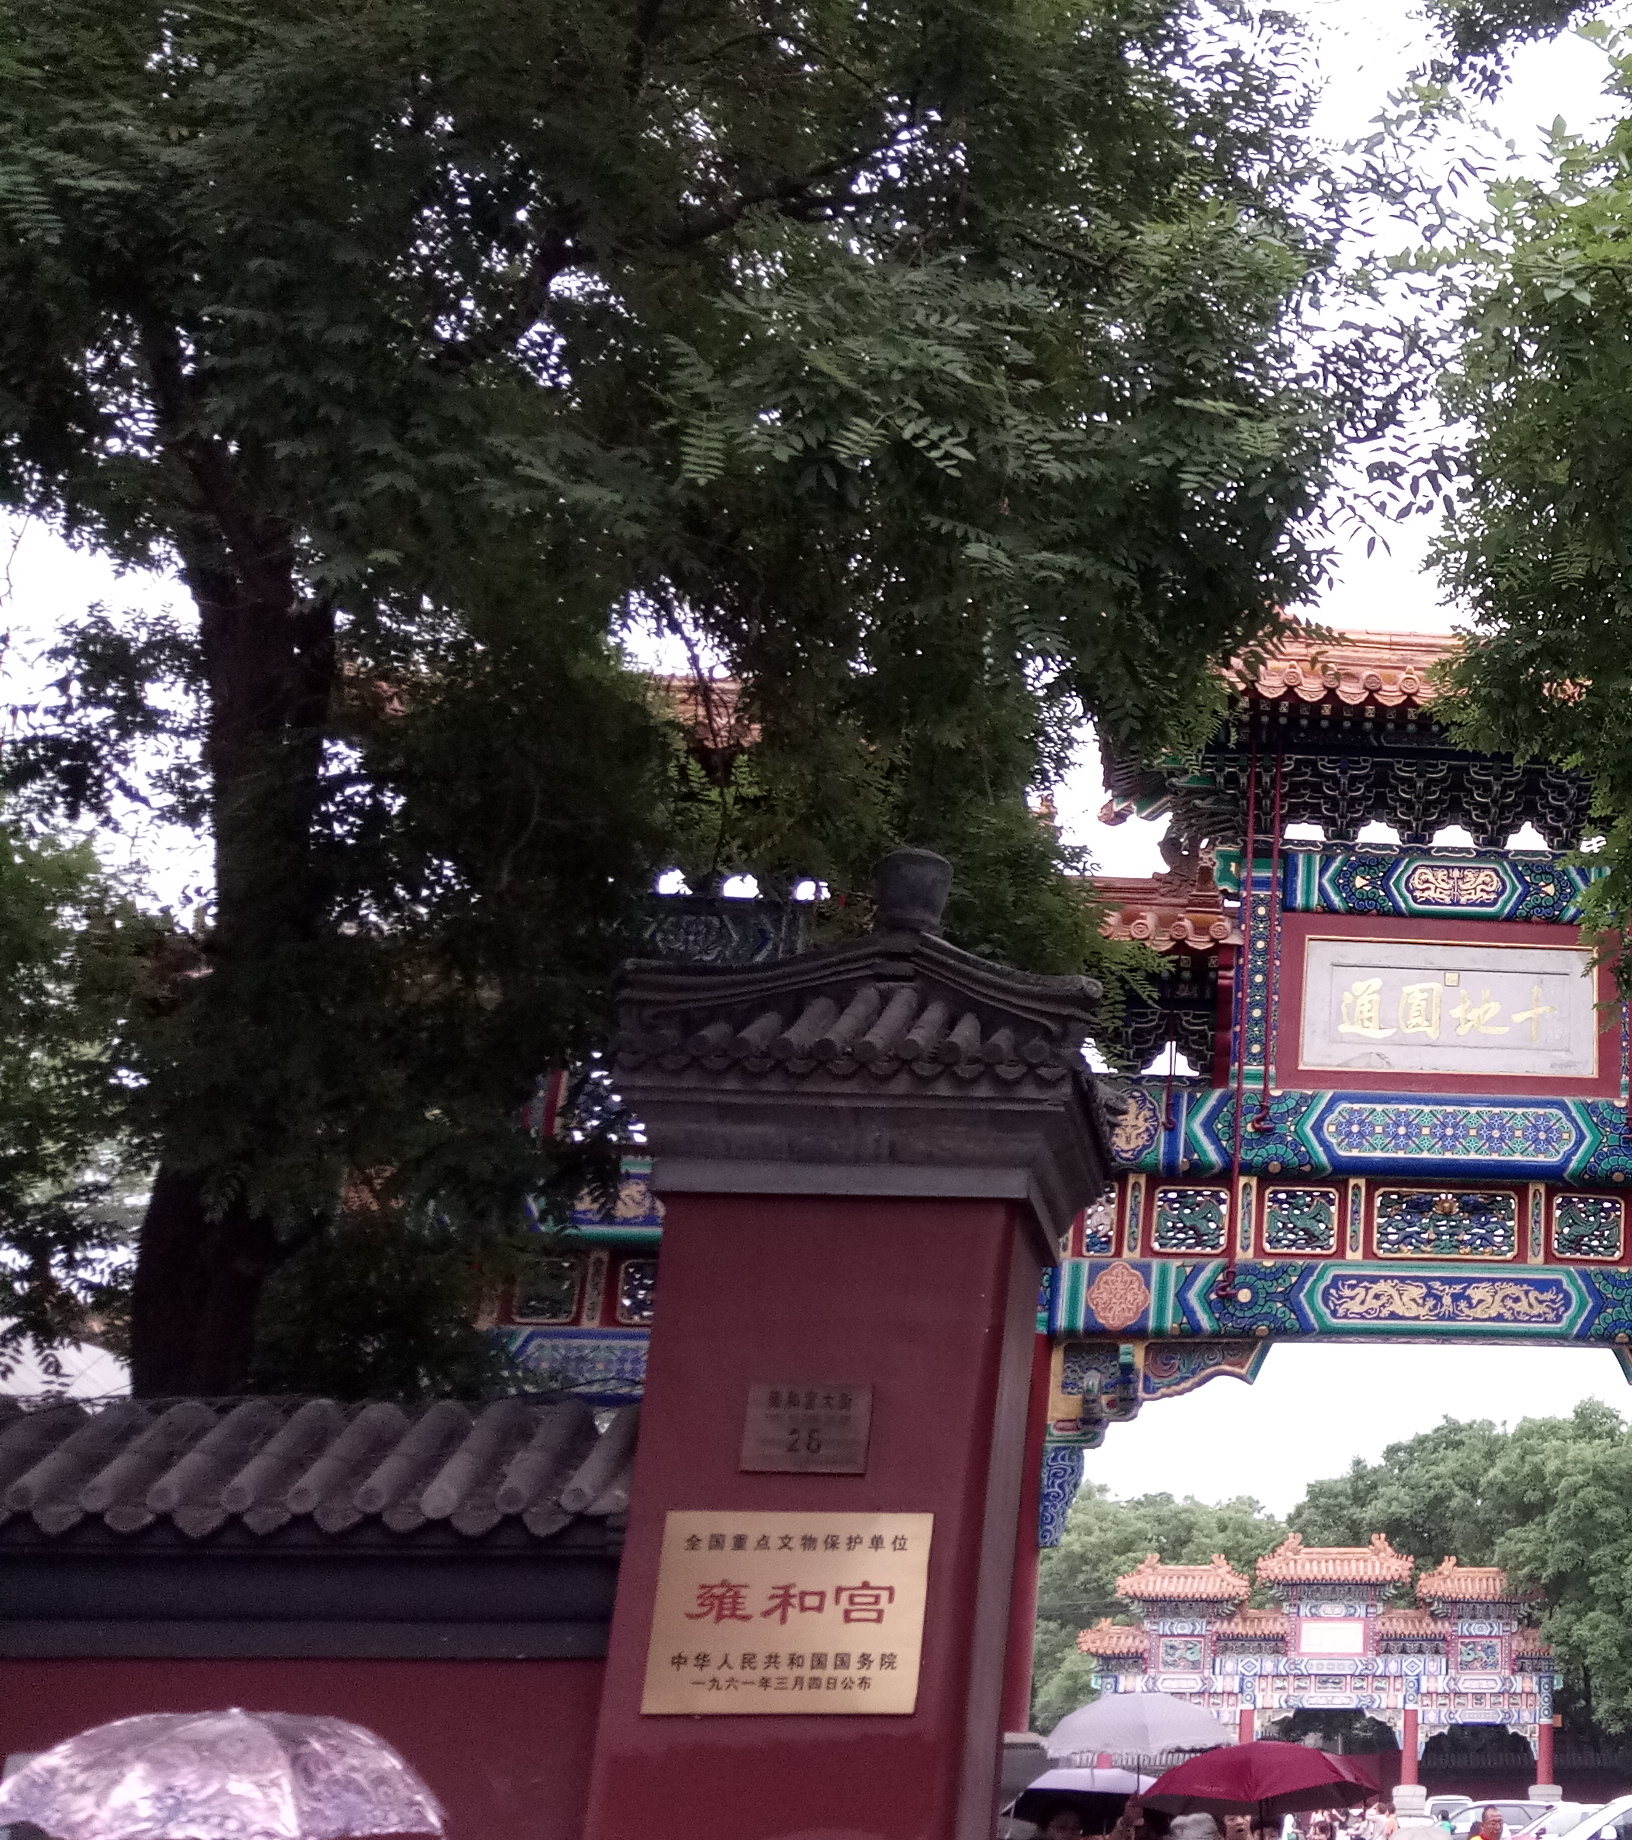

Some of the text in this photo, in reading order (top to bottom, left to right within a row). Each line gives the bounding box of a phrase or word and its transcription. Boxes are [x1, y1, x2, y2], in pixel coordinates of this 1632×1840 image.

[685, 1533, 909, 1551] 全国重点文物保护单位
[684, 1578, 896, 1625] 雍和宫
[671, 1651, 899, 1671] 中华人民共和国国务院
[690, 1676, 873, 1691] 一九六一年三月四日公布
